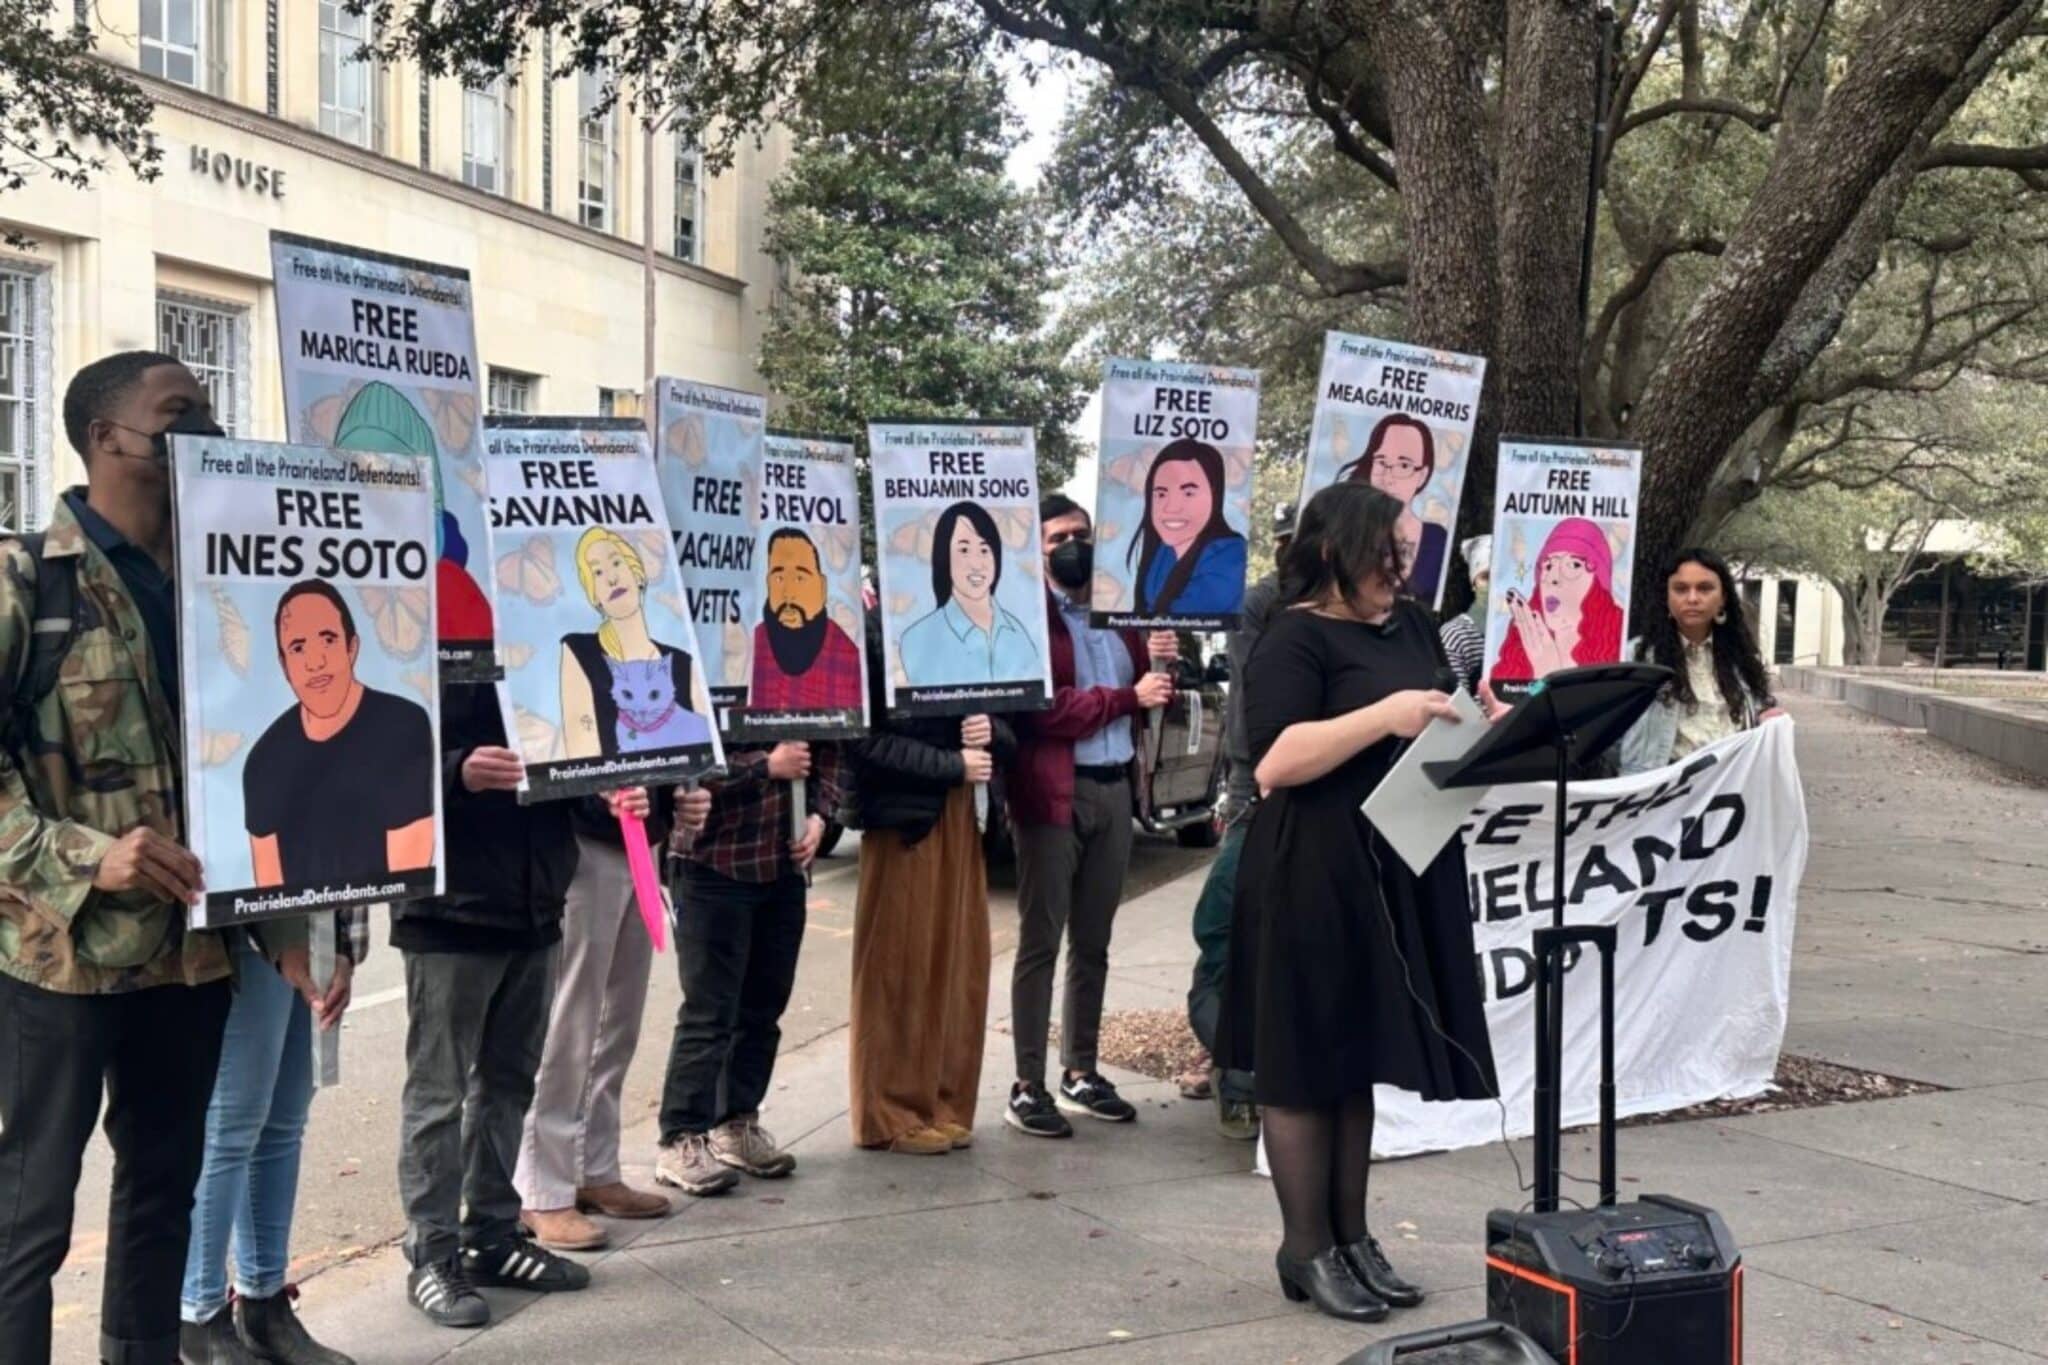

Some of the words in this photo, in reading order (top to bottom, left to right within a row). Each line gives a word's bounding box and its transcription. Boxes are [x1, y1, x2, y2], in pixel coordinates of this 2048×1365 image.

[190, 144, 286, 200] HOUSE
[293, 256, 318, 279] Free
[333, 264, 351, 285] the
[352, 267, 406, 294] Prairieland
[352, 299, 418, 343] FREE
[301, 330, 401, 372] MARICELA
[406, 348, 472, 381] RUEDA
[1380, 366, 1428, 393] FREE
[1155, 388, 1212, 413] FREE
[1328, 382, 1404, 411] MEAGAN
[1405, 395, 1471, 422] MORRIS
[1133, 414, 1165, 436] LIZ
[1169, 416, 1229, 440] SOTO
[202, 452, 232, 473] Free
[237, 454, 253, 475] all
[256, 457, 276, 477] the
[279, 456, 348, 482] Prairieland
[350, 462, 420, 486] Defendants!
[520, 461, 598, 489] FREE
[765, 463, 807, 490] FREE
[929, 451, 986, 475] FREE
[693, 476, 743, 516] FREE
[885, 479, 974, 498] BENJAMIN
[979, 479, 1029, 498] SONG
[1547, 469, 1591, 491] FREE
[276, 488, 362, 530] FREE
[775, 493, 847, 525] REVOL
[1504, 492, 1586, 516] AUTUMN
[1592, 496, 1629, 518] HILL
[207, 533, 304, 577] INES
[316, 537, 427, 580] SOTO
[686, 587, 741, 624] VETTS
[550, 754, 690, 780] PrairielandDefendants.com
[234, 882, 405, 914] PrairielandDefendants.com
